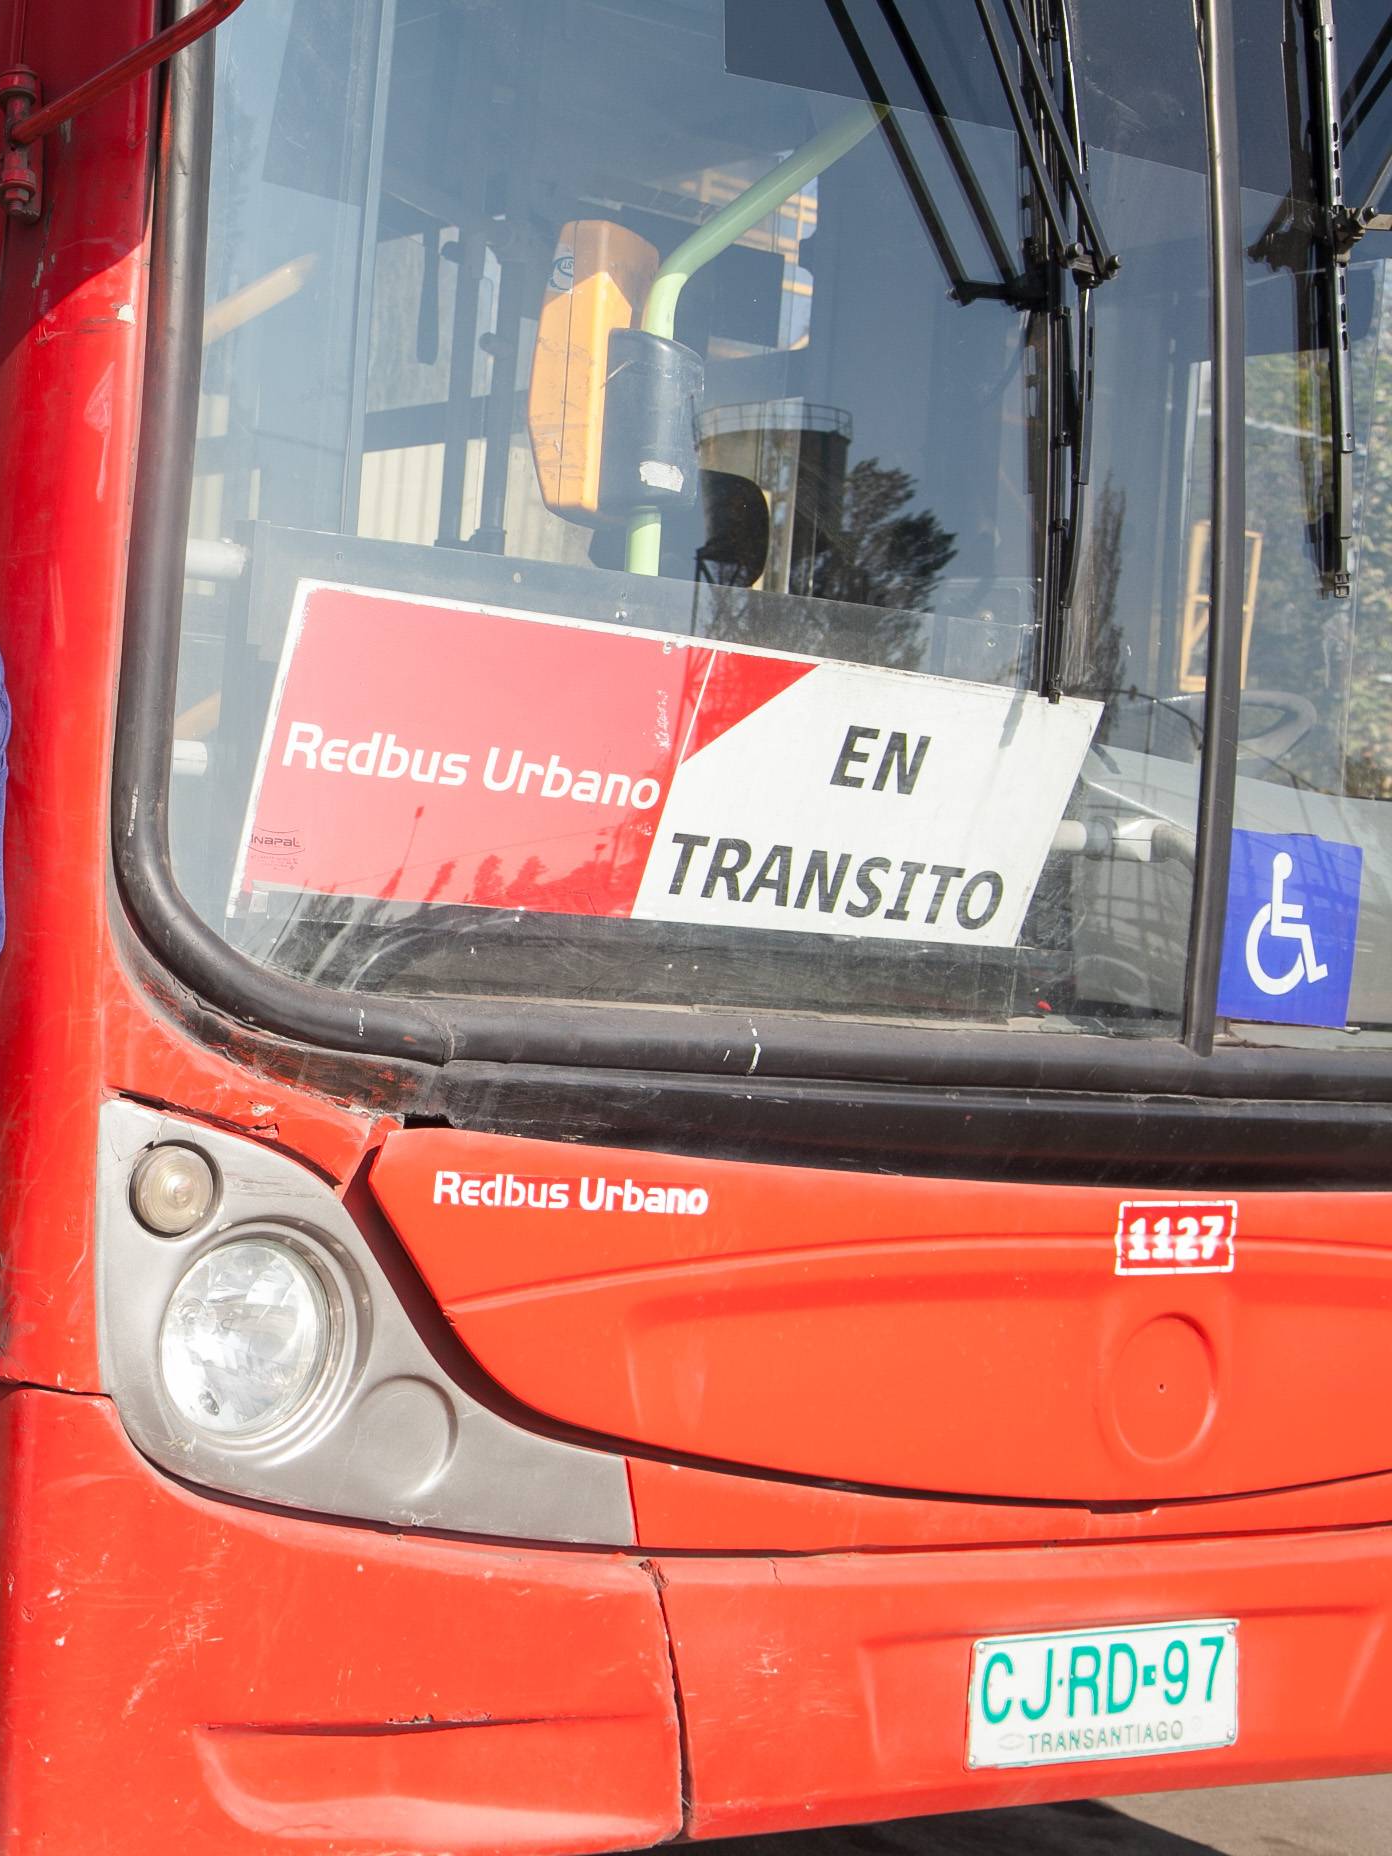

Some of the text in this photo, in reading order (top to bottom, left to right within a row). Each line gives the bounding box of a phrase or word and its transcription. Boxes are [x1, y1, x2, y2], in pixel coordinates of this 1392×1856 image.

[282, 720, 661, 810] Redbus Urbano
[829, 725, 932, 796] EN
[667, 832, 1005, 931] TRANSITO
[433, 1170, 709, 1216] Redbus Urbano
[1128, 1215, 1225, 1261] 1127
[1028, 1719, 1184, 1755] TRANSANTIAGO
